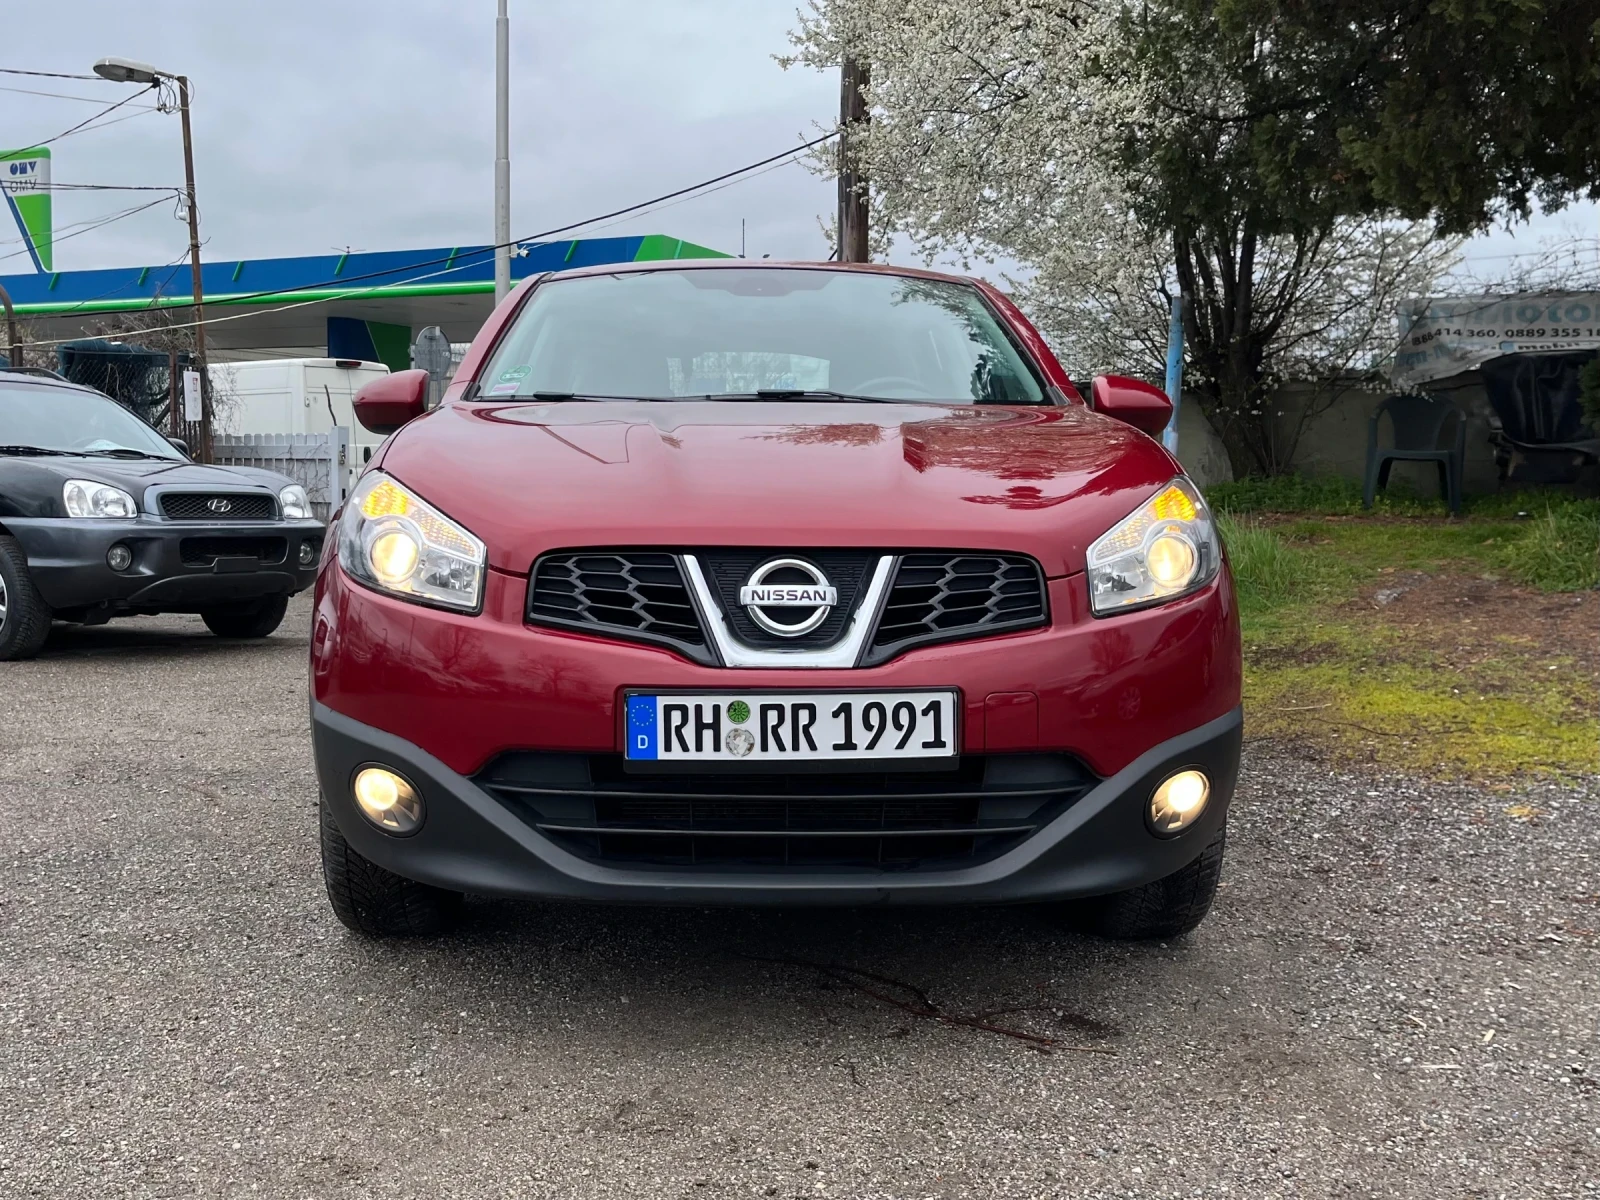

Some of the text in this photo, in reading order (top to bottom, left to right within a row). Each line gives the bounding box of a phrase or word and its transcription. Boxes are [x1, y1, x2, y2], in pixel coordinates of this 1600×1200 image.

[10, 161, 37, 175] OMV
[1434, 328, 1461, 337] 414
[1505, 328, 1546, 338] 0889
[1551, 328, 1581, 337] 355
[751, 589, 827, 602] NISSAN
[637, 700, 947, 752] D RH RR 1991
